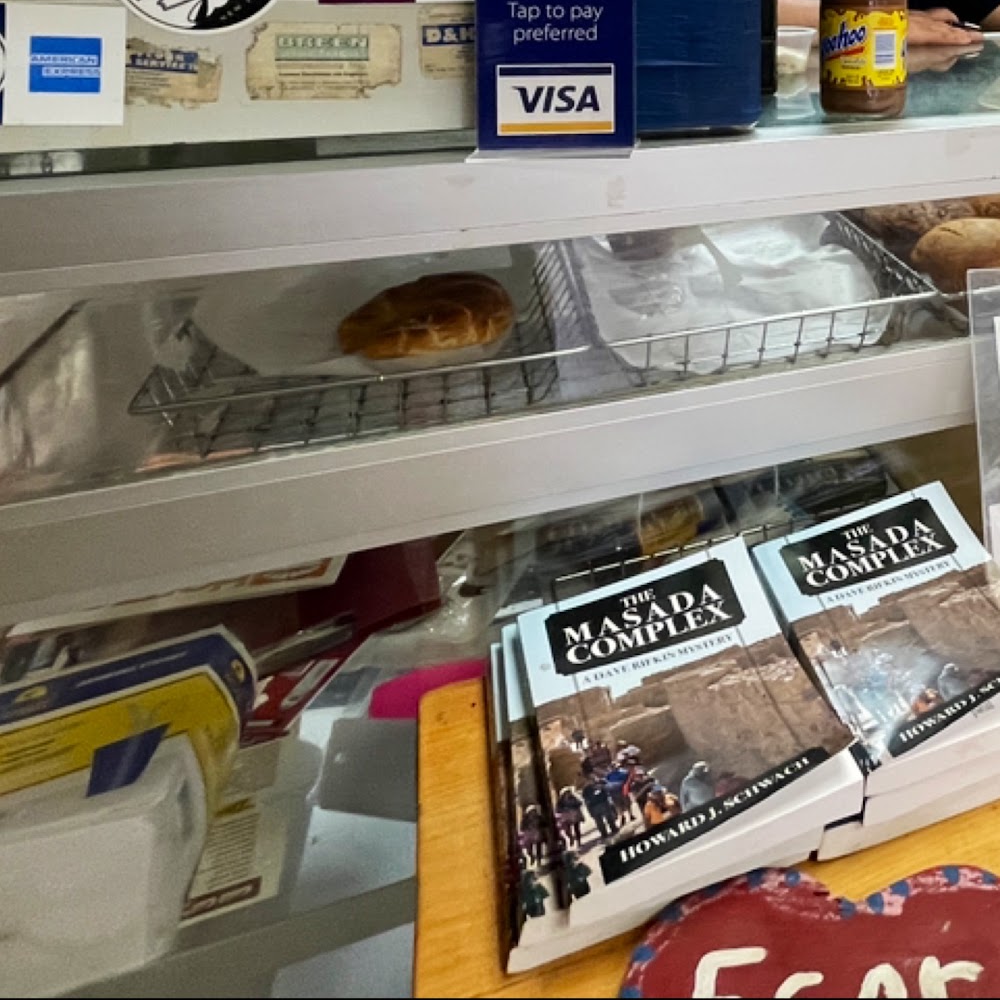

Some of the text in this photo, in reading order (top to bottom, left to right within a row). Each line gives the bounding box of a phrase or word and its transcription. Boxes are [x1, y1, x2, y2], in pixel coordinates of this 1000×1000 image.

[507, 1, 604, 23] Tap to pay
[513, 24, 598, 45] preferred
[512, 85, 601, 114] VISA
[798, 518, 935, 573] MASADA
[841, 523, 874, 540] THE
[805, 532, 947, 588] COMPLEX
[562, 583, 723, 646] MASADA
[620, 588, 656, 609] THE
[565, 600, 733, 665] COMPLEX
[899, 699, 968, 743] HOWARD
[619, 756, 811, 863] HOWARD J. SCHWACH
